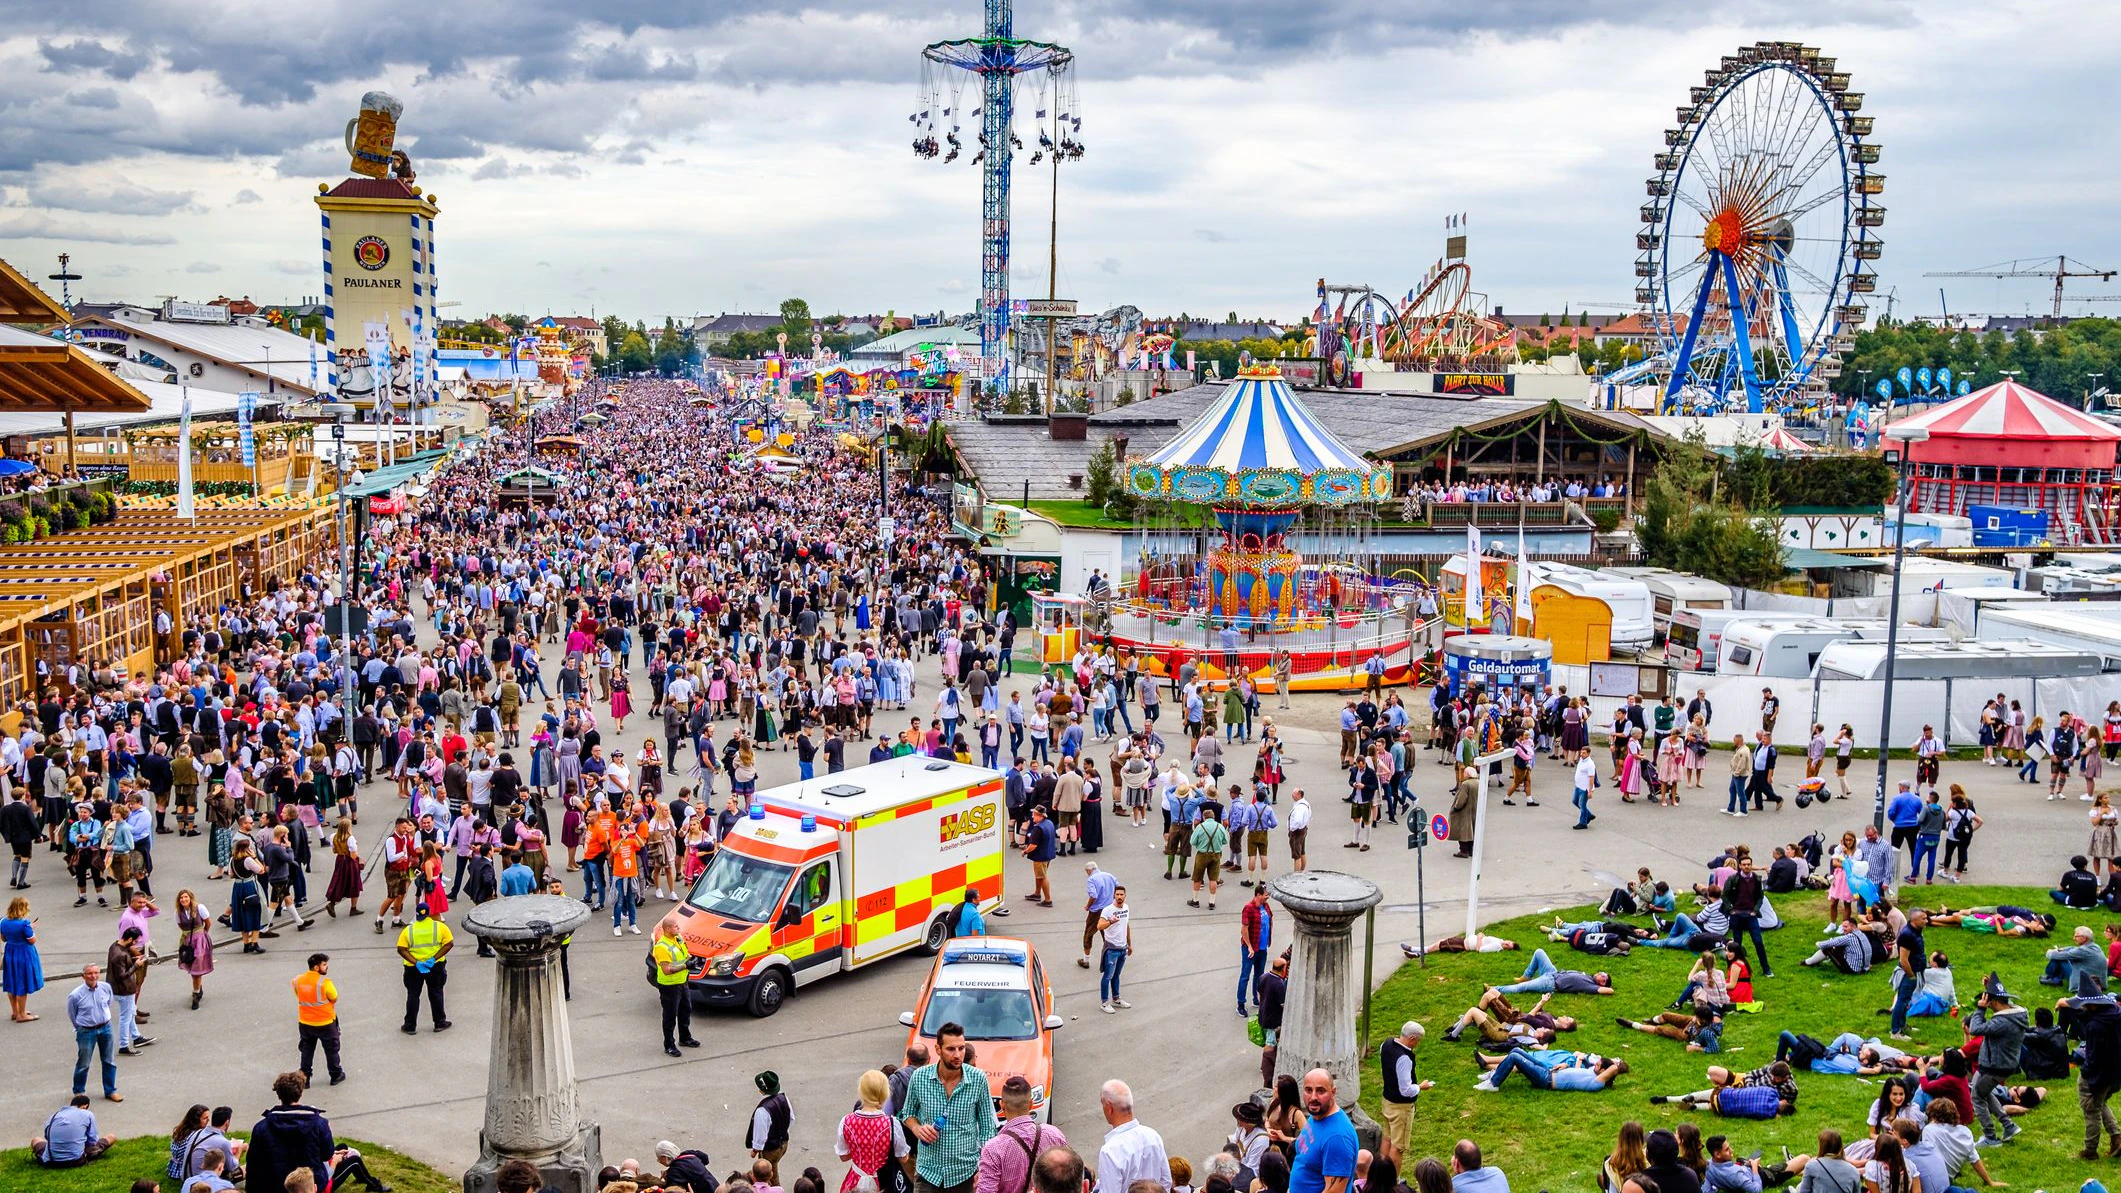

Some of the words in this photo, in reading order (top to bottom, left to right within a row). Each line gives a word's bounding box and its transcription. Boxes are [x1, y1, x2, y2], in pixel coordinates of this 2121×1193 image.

[344, 277, 402, 289] PAULANER
[911, 350, 941, 366] BREAK
[918, 359, 947, 376] DANCE
[1444, 374, 1467, 393] FAHRT
[1468, 374, 1482, 385] ZUR
[1468, 659, 1541, 675] Geldautomat
[954, 803, 996, 838] ASB
[940, 831, 996, 852] Arbeiter-Samariter-Bund
[876, 897, 887, 909] 112
[968, 953, 1000, 962] NOTARZT
